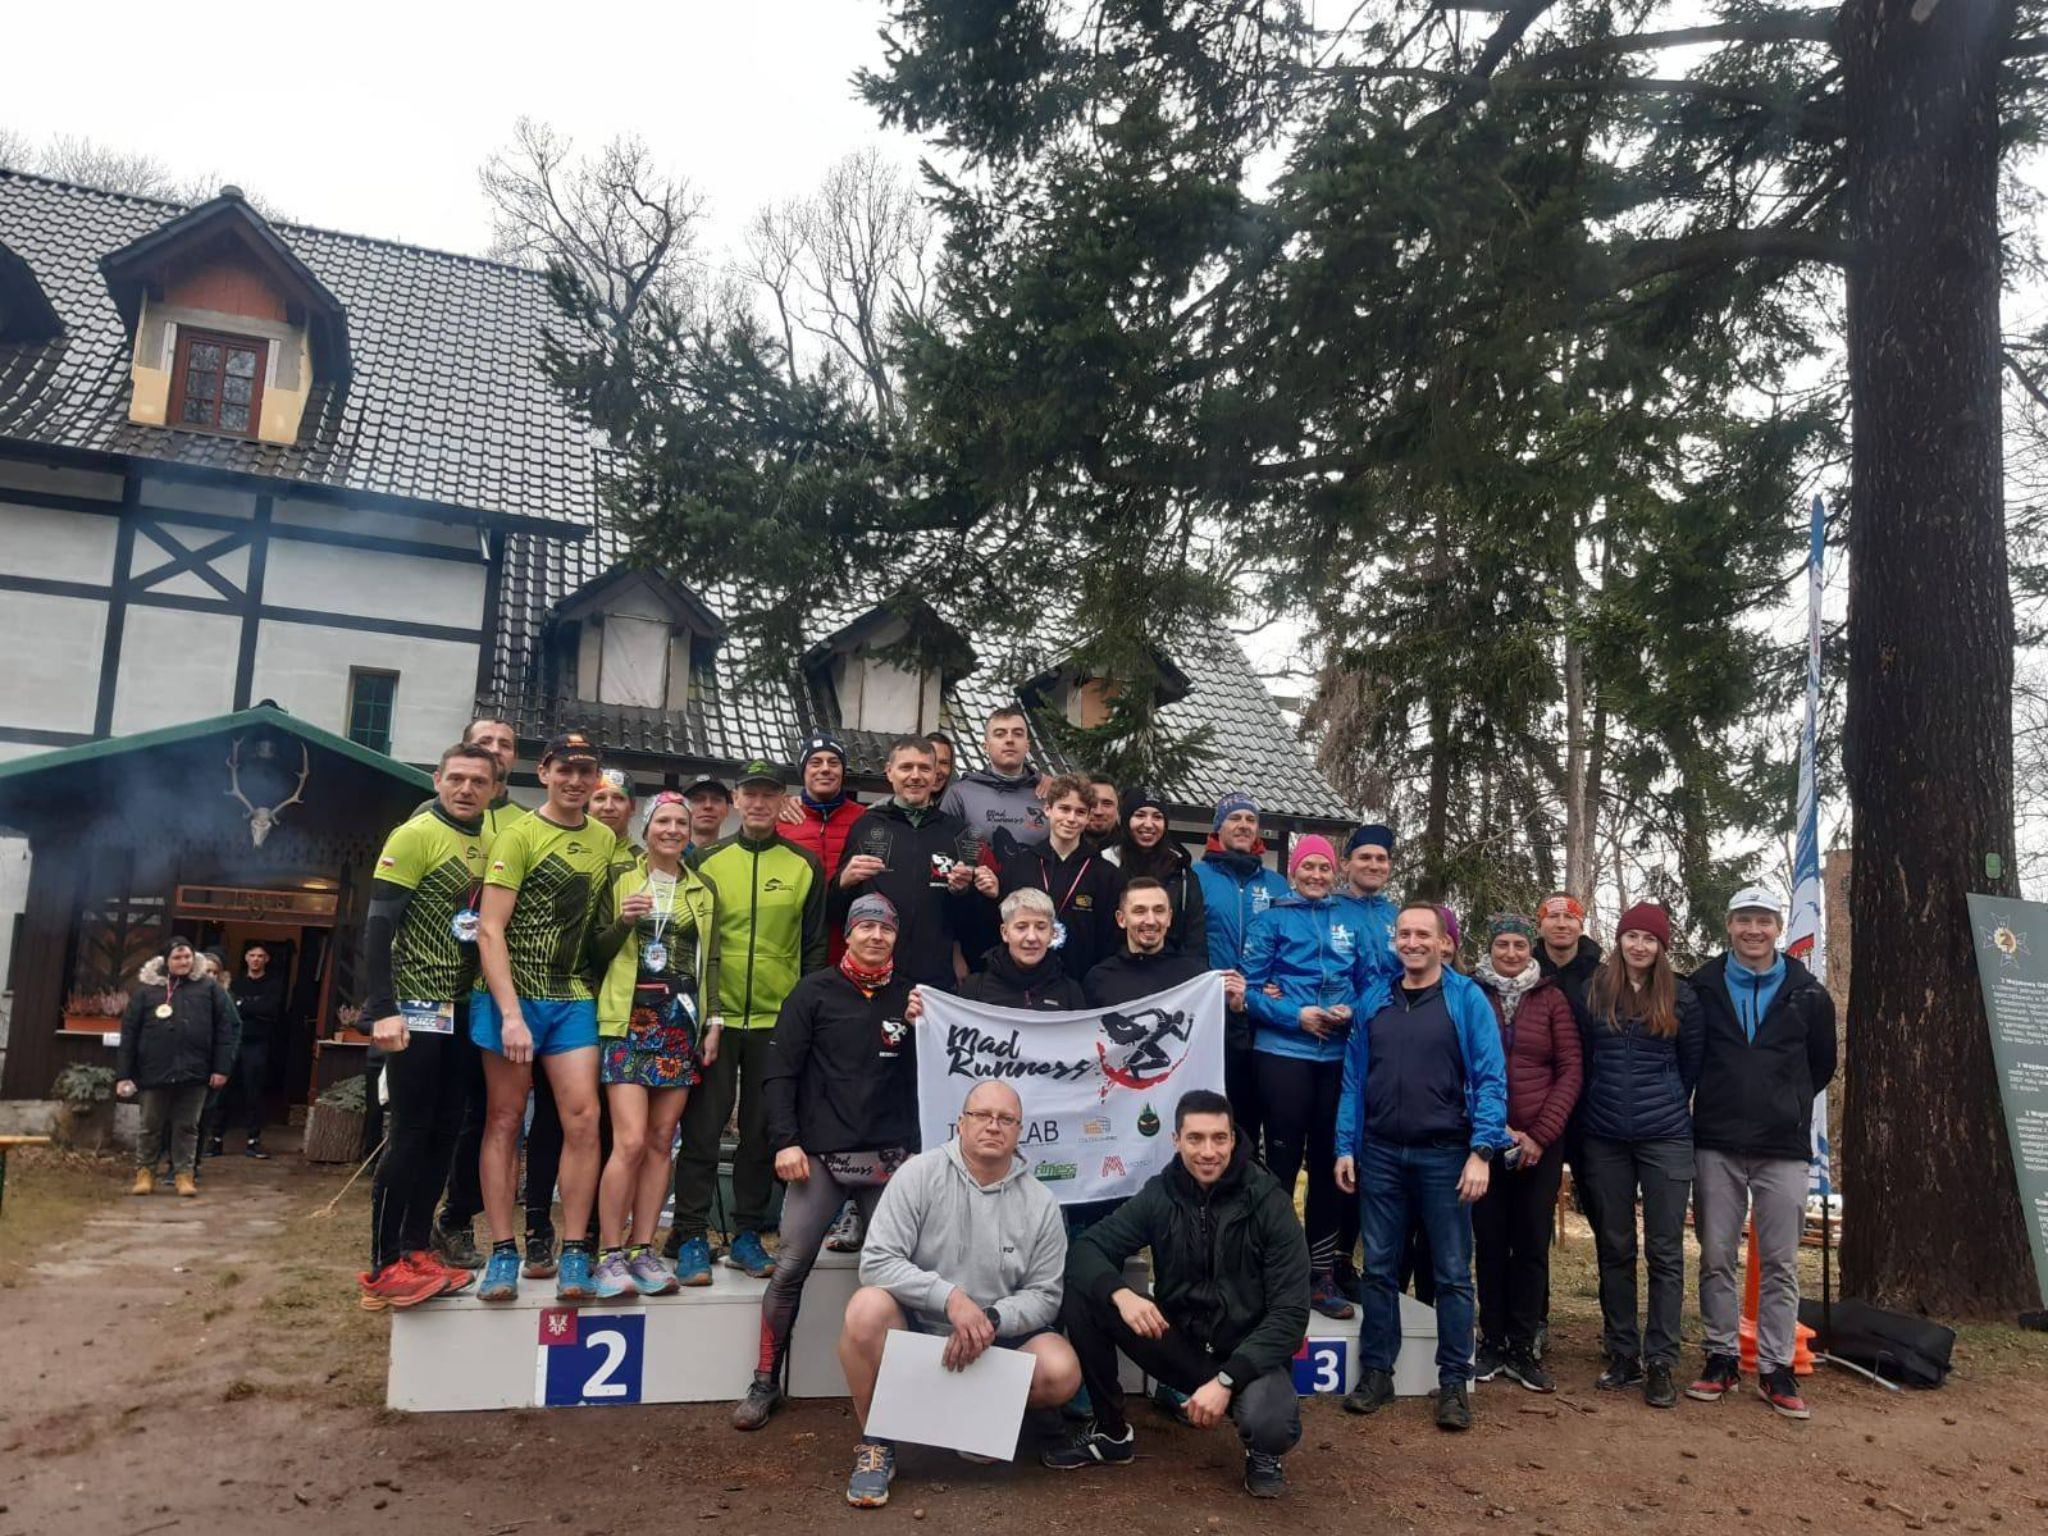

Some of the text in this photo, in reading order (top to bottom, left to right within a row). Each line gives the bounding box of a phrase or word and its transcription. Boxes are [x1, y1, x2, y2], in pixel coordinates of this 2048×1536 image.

[946, 1024, 1019, 1059] Mad
[946, 1045, 1093, 1080] Runners
[582, 1330, 627, 1397] 2
[1313, 1349, 1339, 1392] 3
